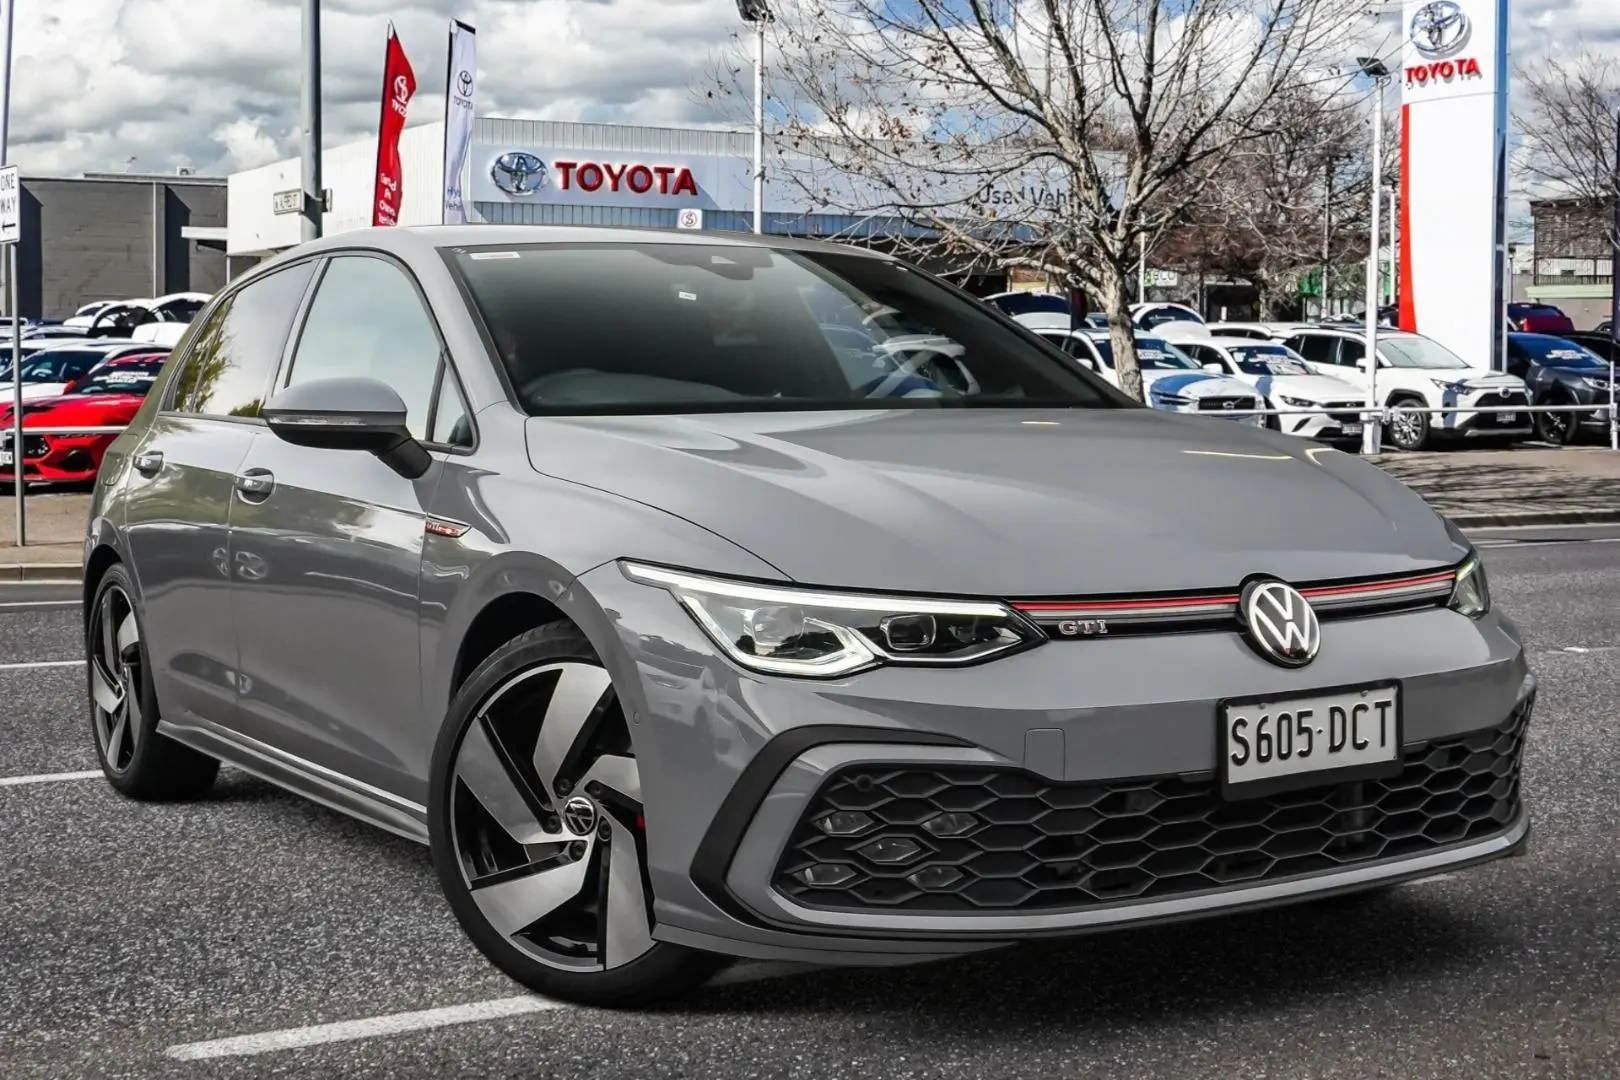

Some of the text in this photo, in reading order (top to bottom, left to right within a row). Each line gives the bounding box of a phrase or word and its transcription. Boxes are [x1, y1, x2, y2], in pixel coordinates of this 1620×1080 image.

[1404, 58, 1480, 83] TOYOTA
[1, 173, 15, 191] ONE
[555, 161, 699, 196] TOYOTA
[1, 196, 16, 213] WAY
[1058, 619, 1109, 635] GTI
